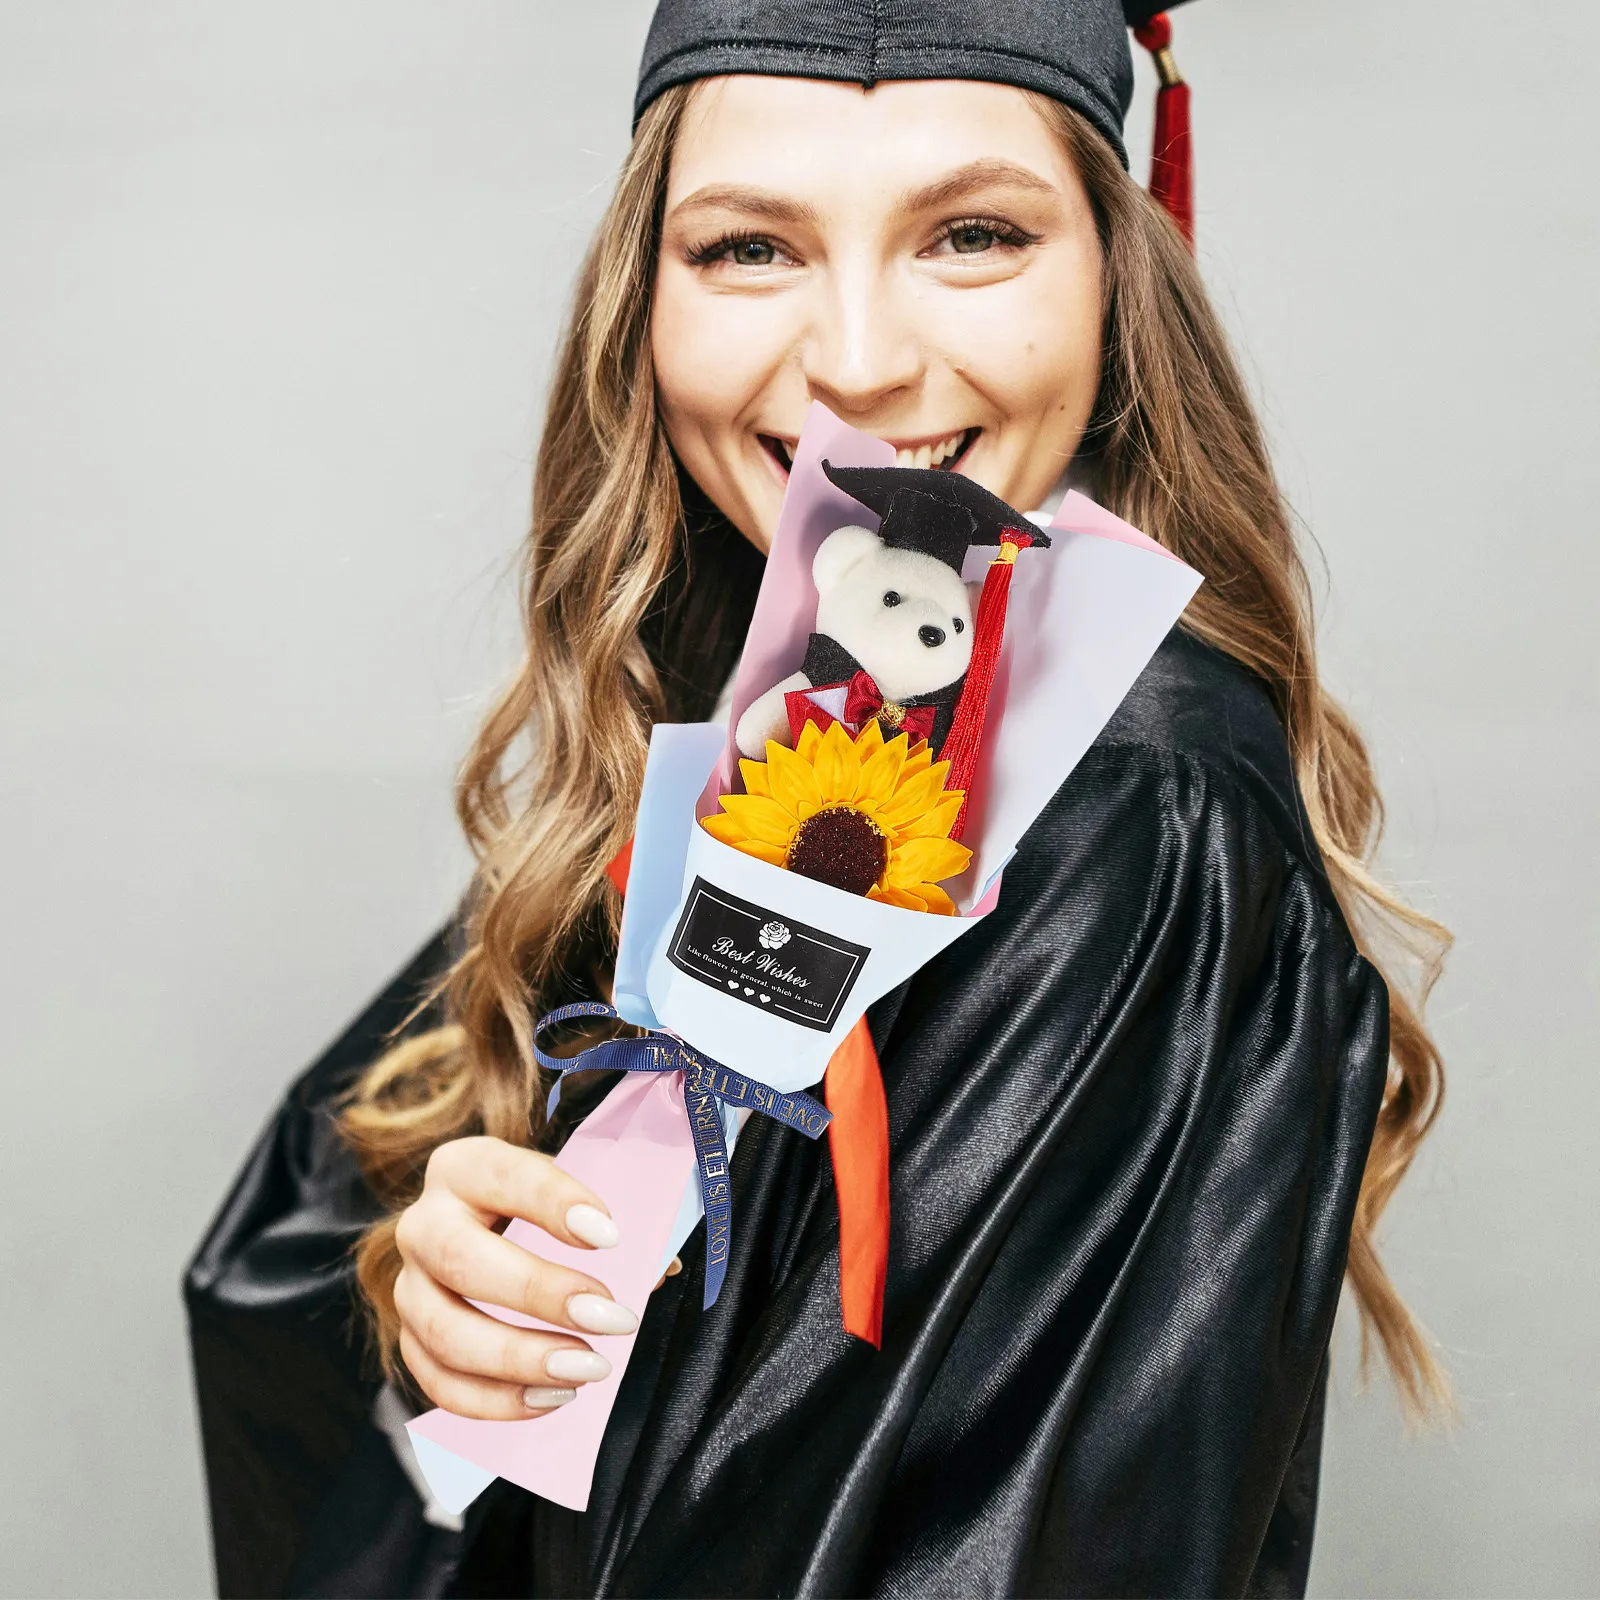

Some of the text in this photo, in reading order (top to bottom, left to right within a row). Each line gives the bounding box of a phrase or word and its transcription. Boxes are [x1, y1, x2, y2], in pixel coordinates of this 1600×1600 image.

[687, 945, 702, 957] Like
[702, 954, 729, 970] flowers
[771, 986, 792, 997] which
[804, 999, 824, 1008] sweet
[712, 937, 812, 987] Best Wishes
[755, 1087, 773, 1109] IS
[708, 1183, 727, 1205] IS
[711, 1208, 729, 1266] LOVE
